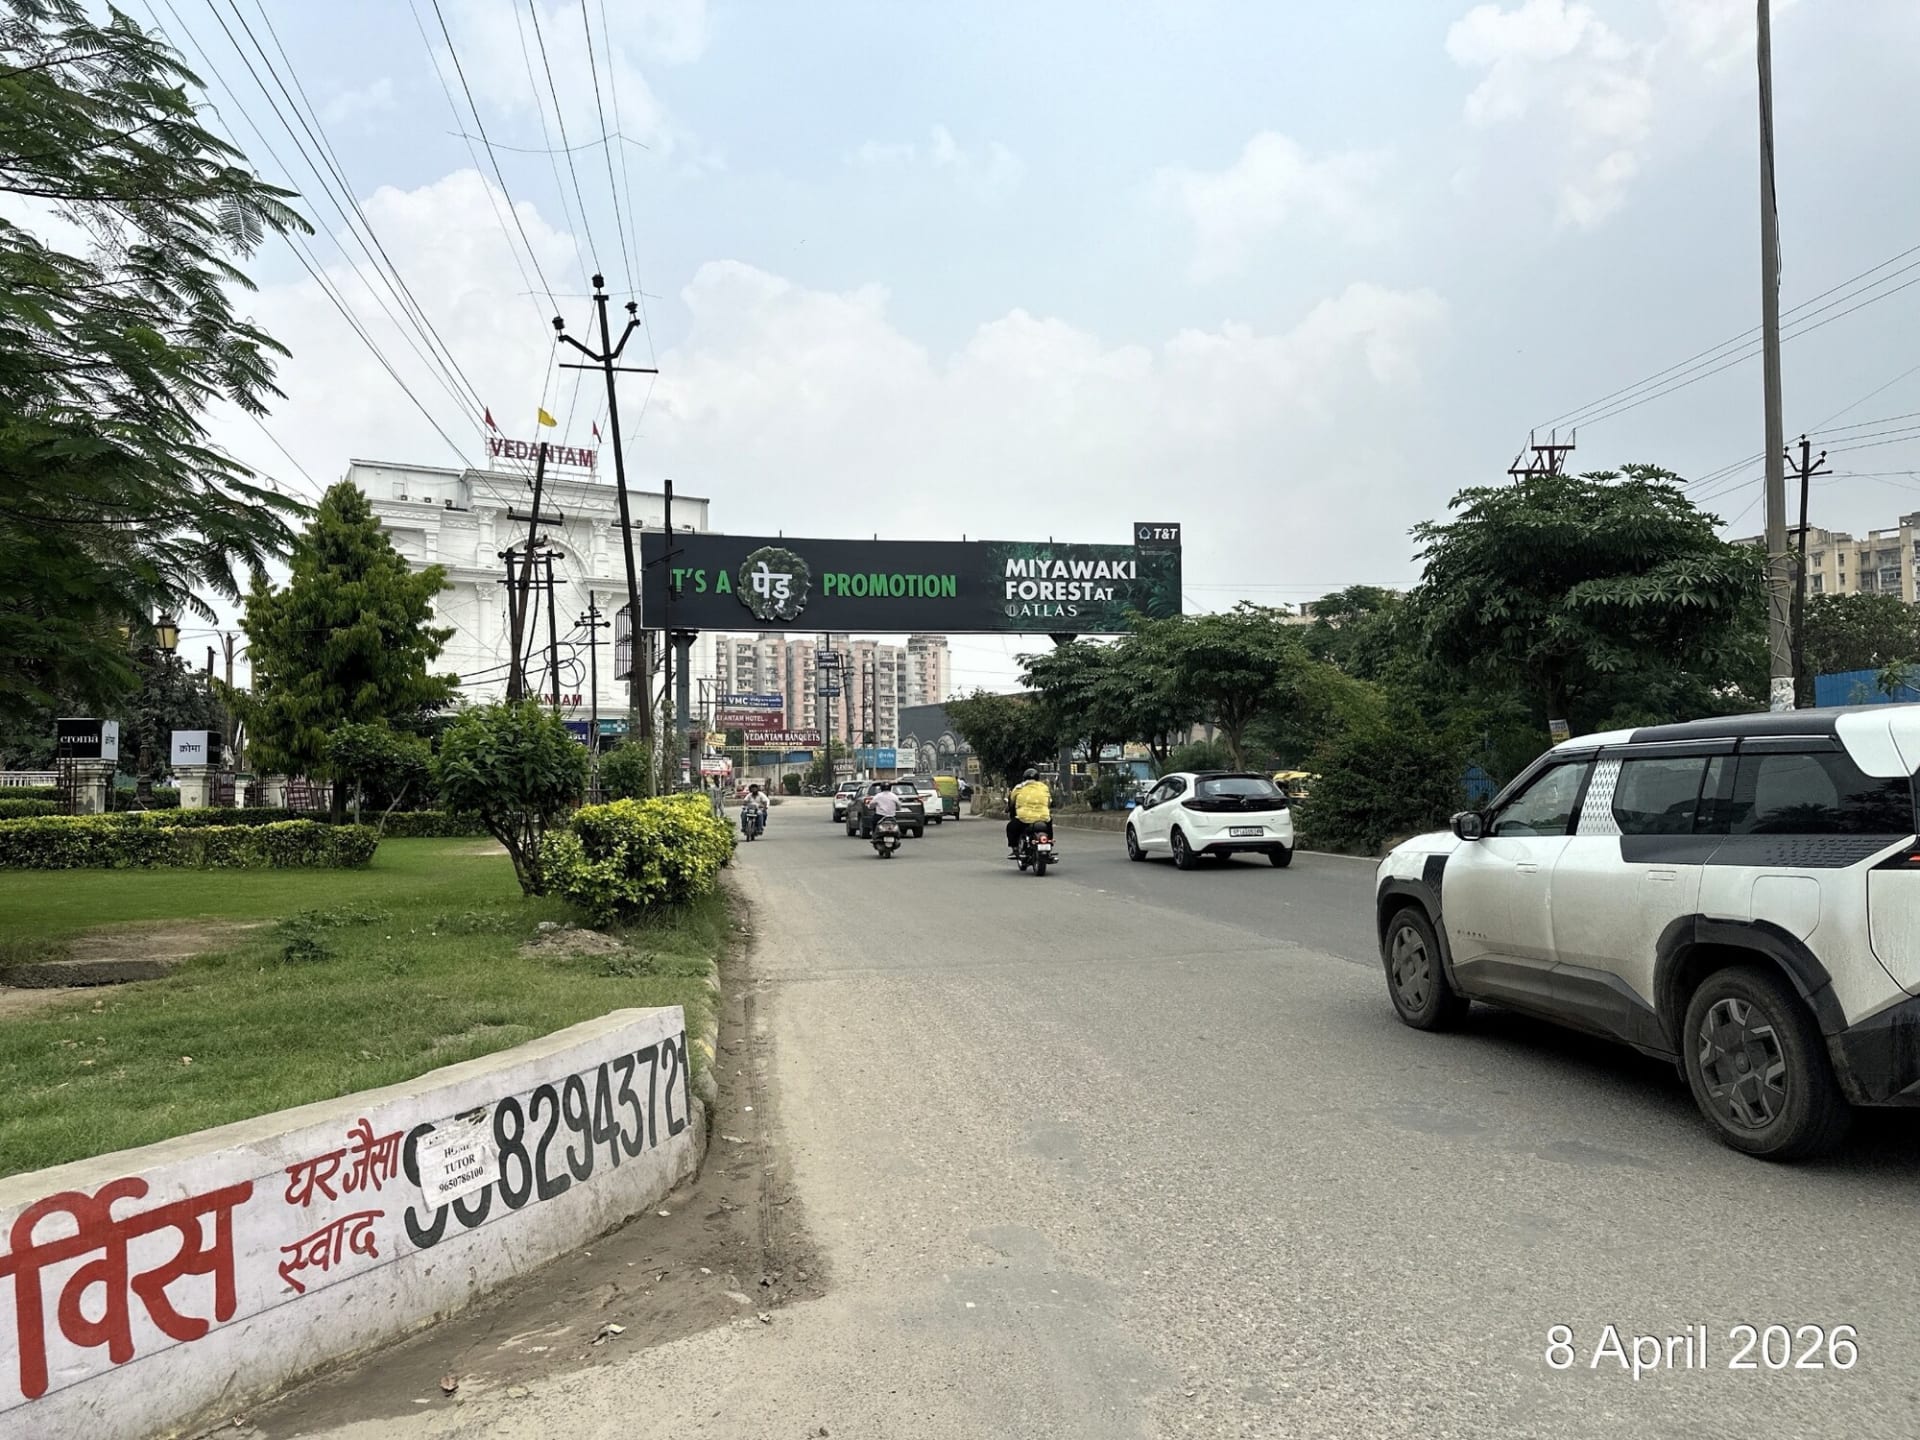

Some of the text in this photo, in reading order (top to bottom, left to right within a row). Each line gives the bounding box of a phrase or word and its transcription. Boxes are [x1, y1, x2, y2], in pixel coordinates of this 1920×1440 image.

[489, 437, 594, 468] VEDANTAM
[1153, 528, 1178, 540] T&T
[1005, 558, 1136, 580] MIYAWAKI
[671, 568, 732, 594] T'S A
[823, 573, 957, 598] PROMOTION
[1005, 581, 1114, 601] FOREST AT
[1020, 603, 1078, 617] ATLAS
[728, 697, 748, 705] VMC
[744, 731, 783, 741] VEDANTAM
[785, 733, 820, 742] BANQUETS
[402, 1030, 692, 1249] 982943721
[285, 1118, 404, 1207] घर जैसा
[444, 1153, 476, 1175] TUTOR
[438, 1165, 484, 1193] 9650786100
[278, 1210, 385, 1294] स्वाद
